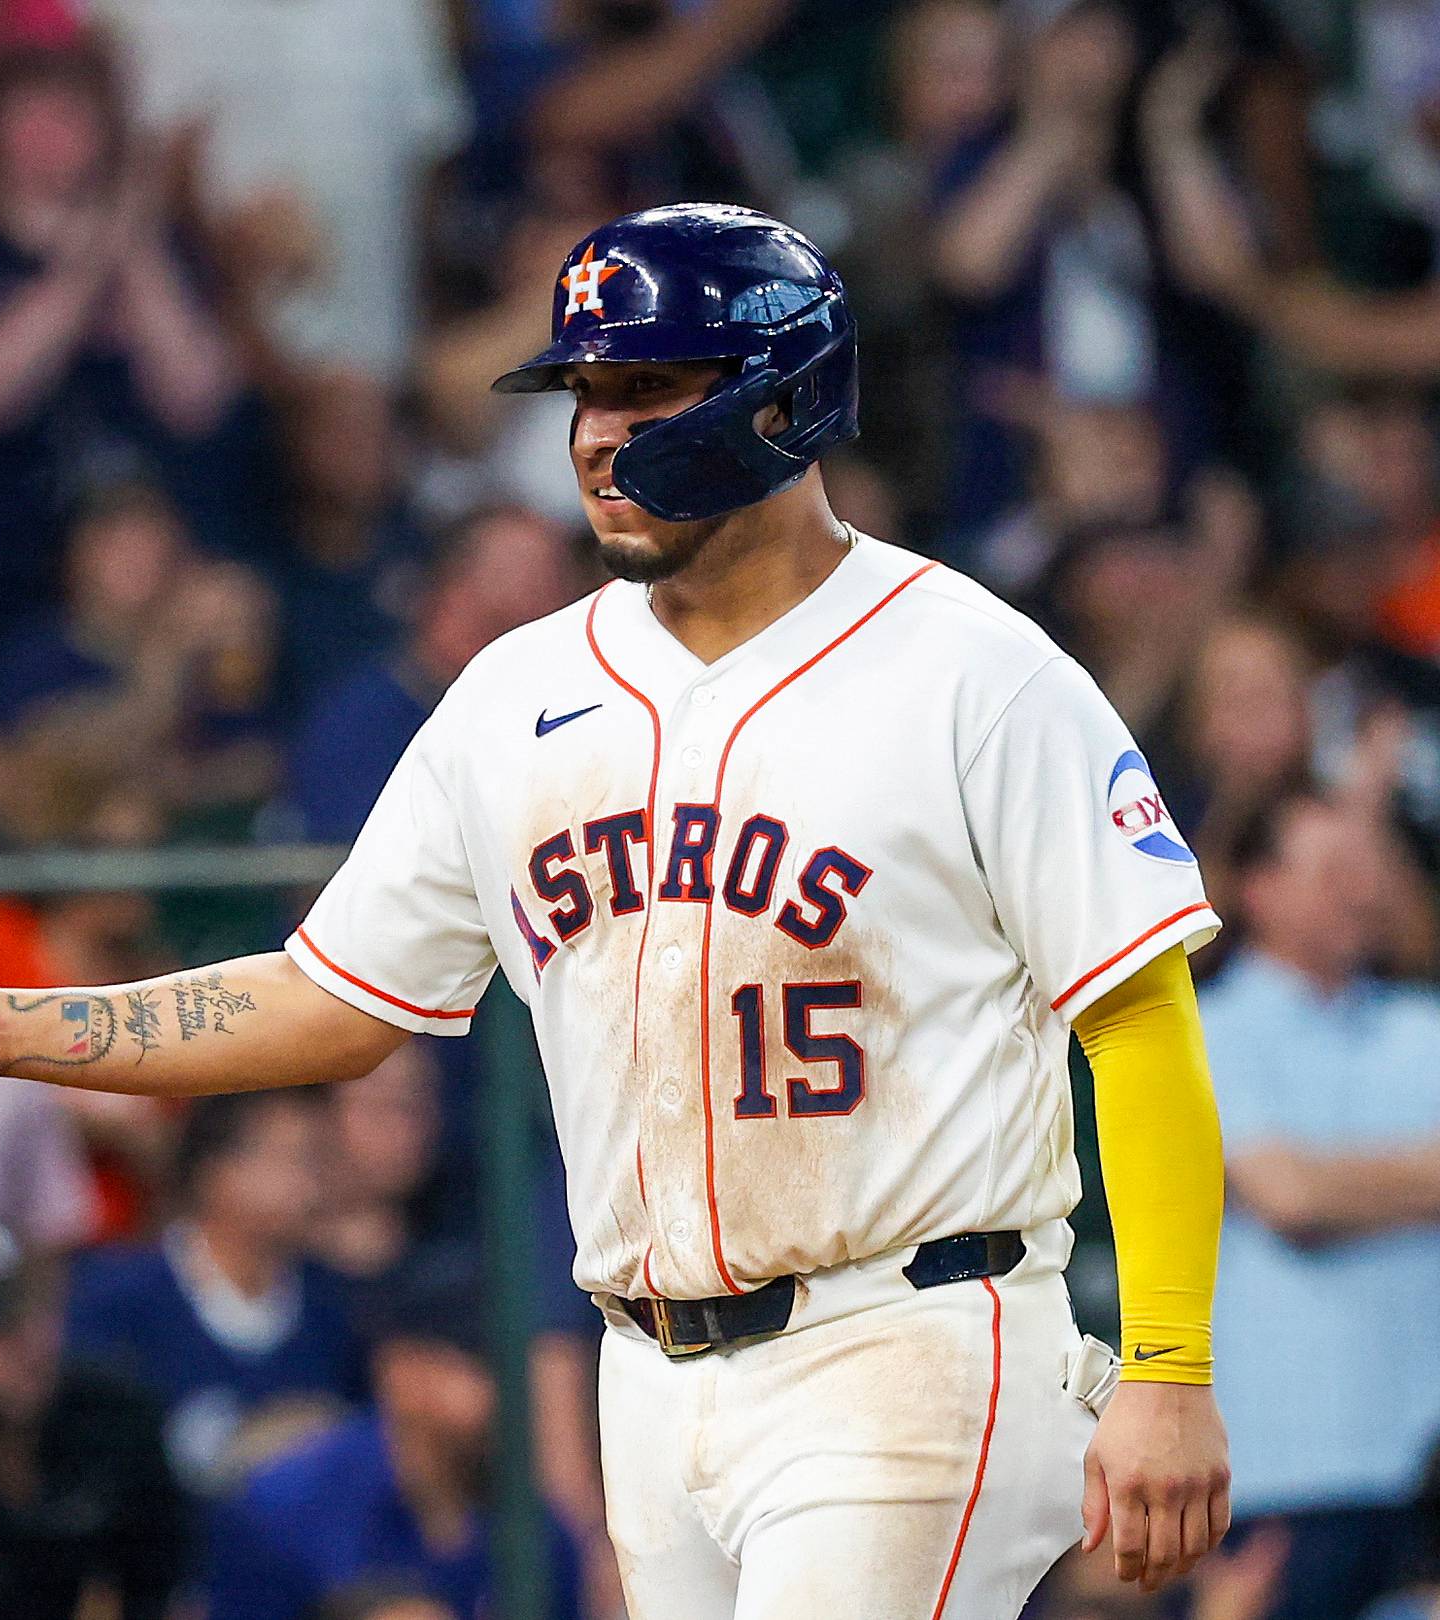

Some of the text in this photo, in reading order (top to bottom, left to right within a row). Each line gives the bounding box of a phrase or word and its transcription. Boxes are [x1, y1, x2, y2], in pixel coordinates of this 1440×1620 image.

[564, 258, 608, 316] H
[1111, 792, 1170, 836] OX
[731, 981, 866, 1119] 15
